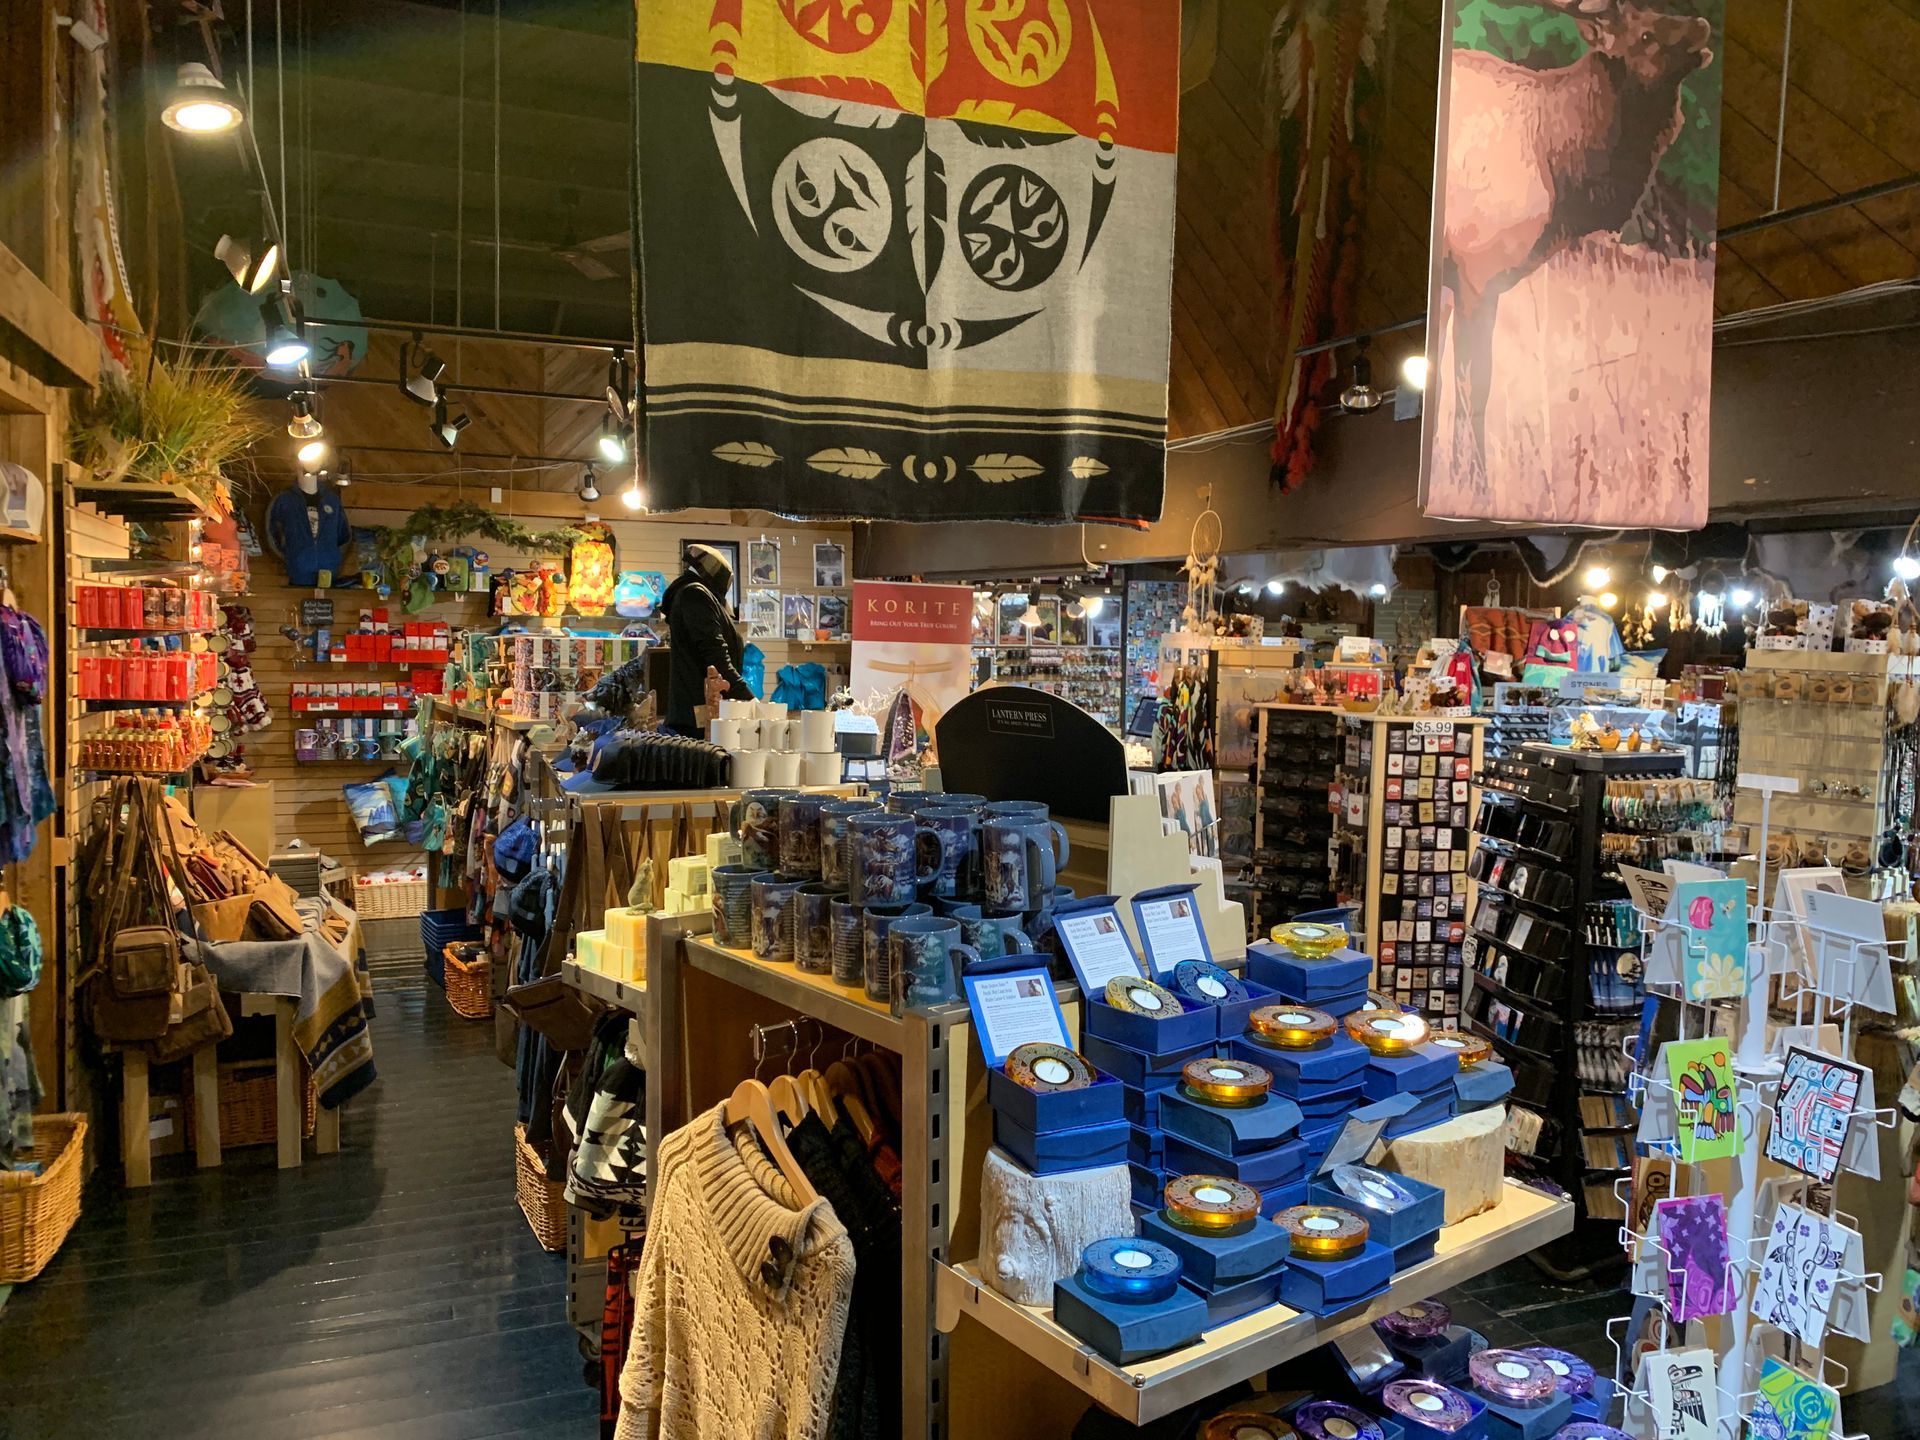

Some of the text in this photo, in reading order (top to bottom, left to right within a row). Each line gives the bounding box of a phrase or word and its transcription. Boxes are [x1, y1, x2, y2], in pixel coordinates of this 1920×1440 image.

[867, 599, 960, 616] KORITE
[991, 708, 1047, 722] LANTERN PRESS
[1415, 721, 1452, 733] $5.99
